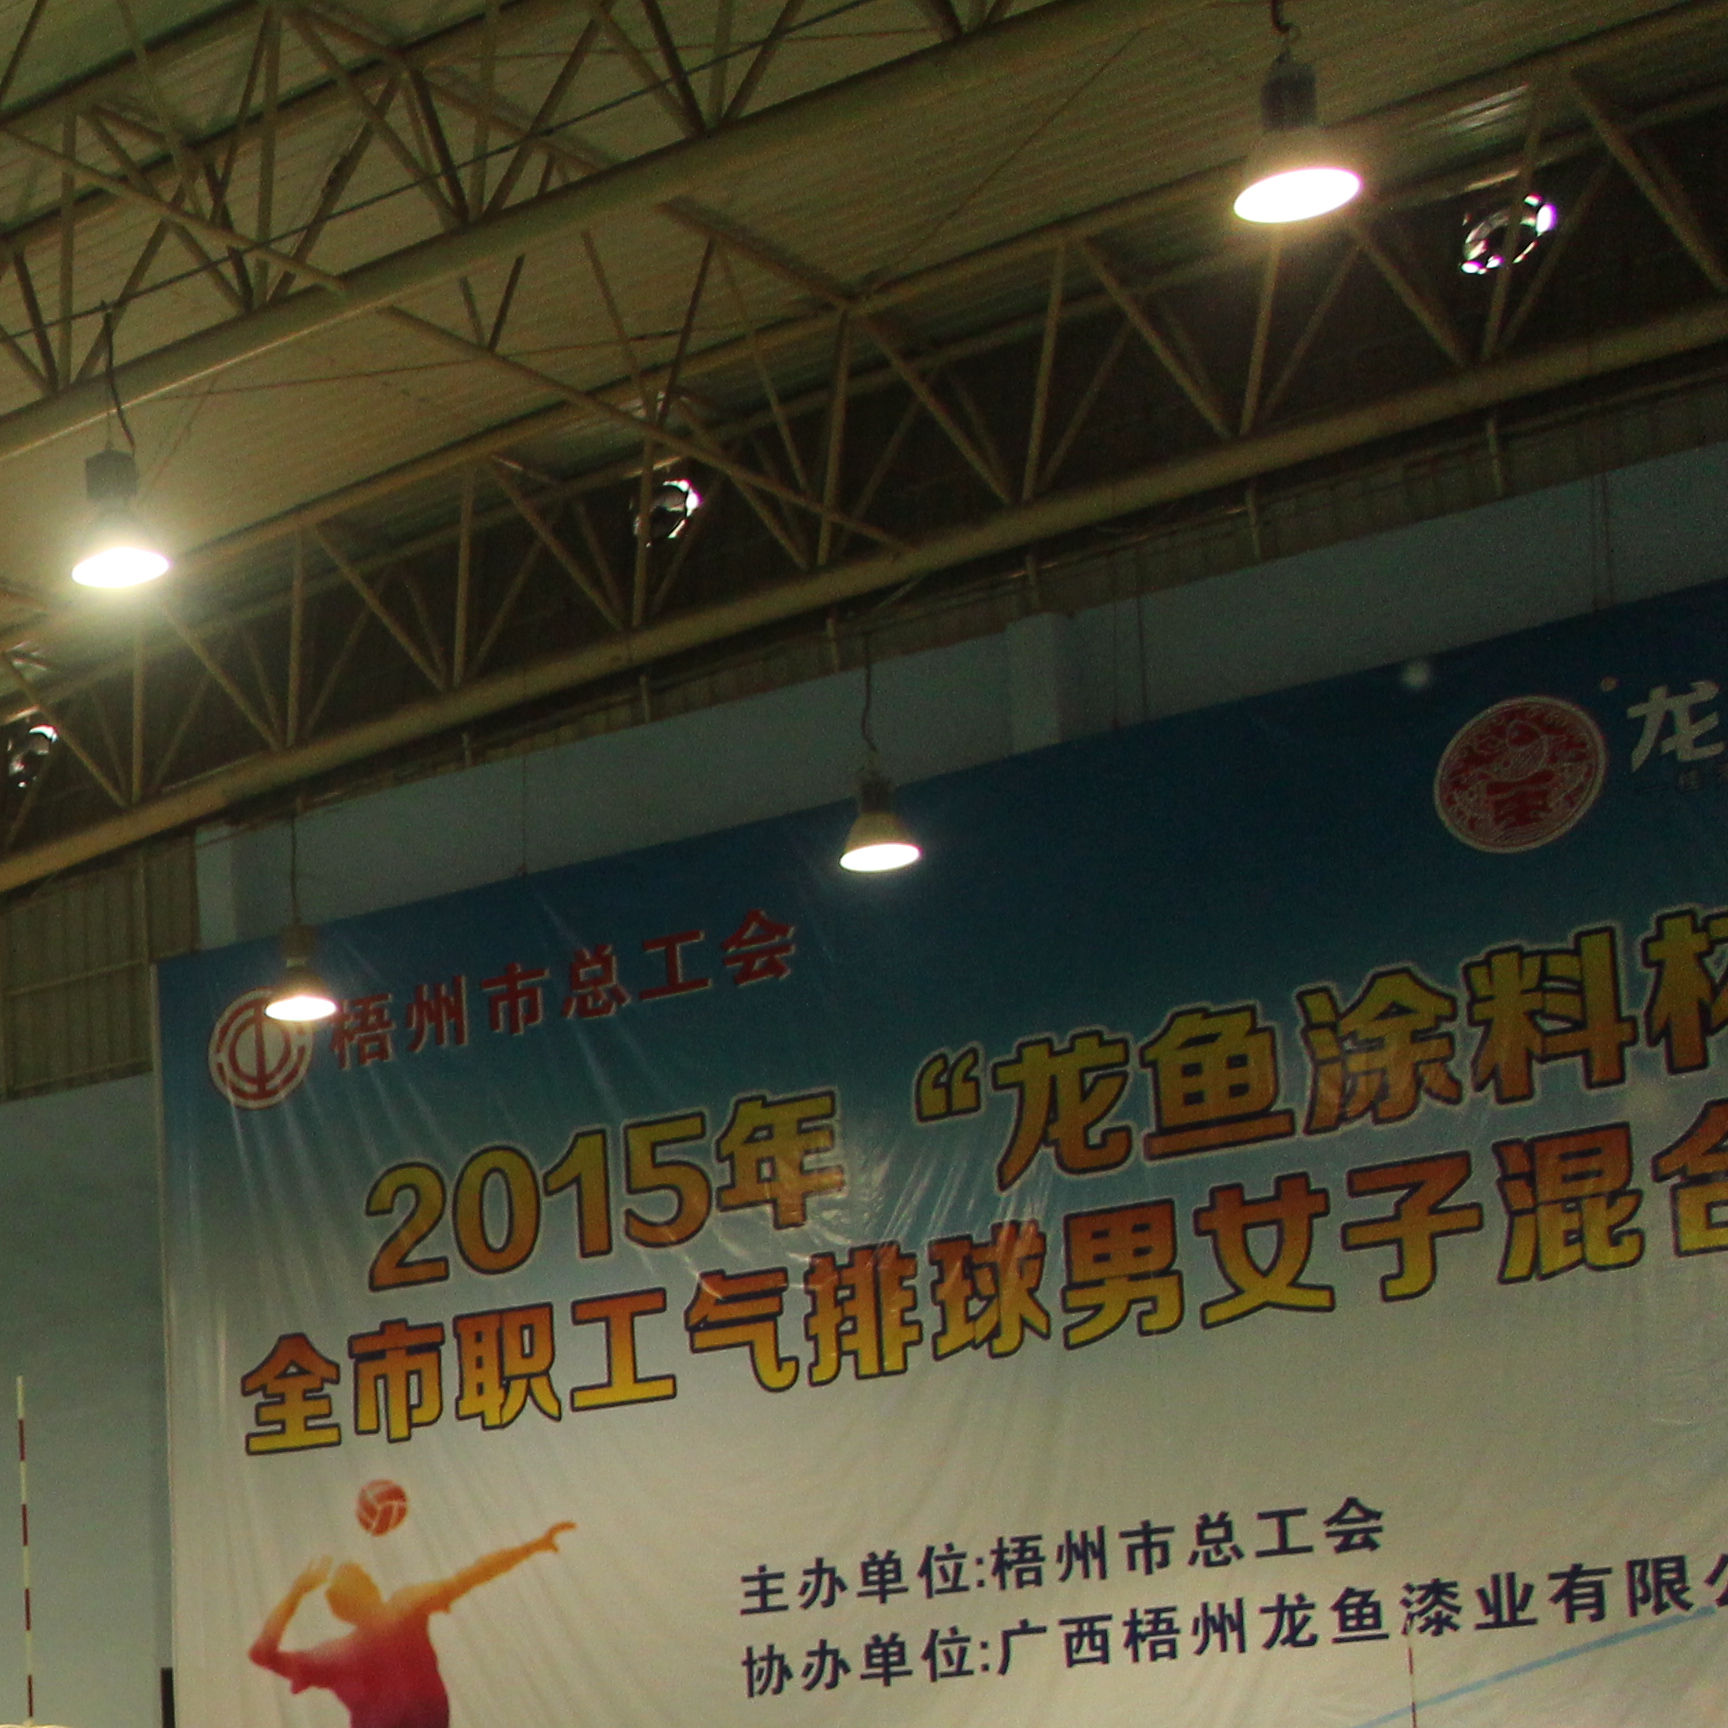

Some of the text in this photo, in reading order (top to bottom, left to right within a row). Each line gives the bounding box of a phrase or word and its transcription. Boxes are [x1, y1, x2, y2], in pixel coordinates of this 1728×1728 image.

[329, 909, 796, 1070] 梧州市总工会
[739, 1497, 1385, 1618] 主办单位:梧州市总工会
